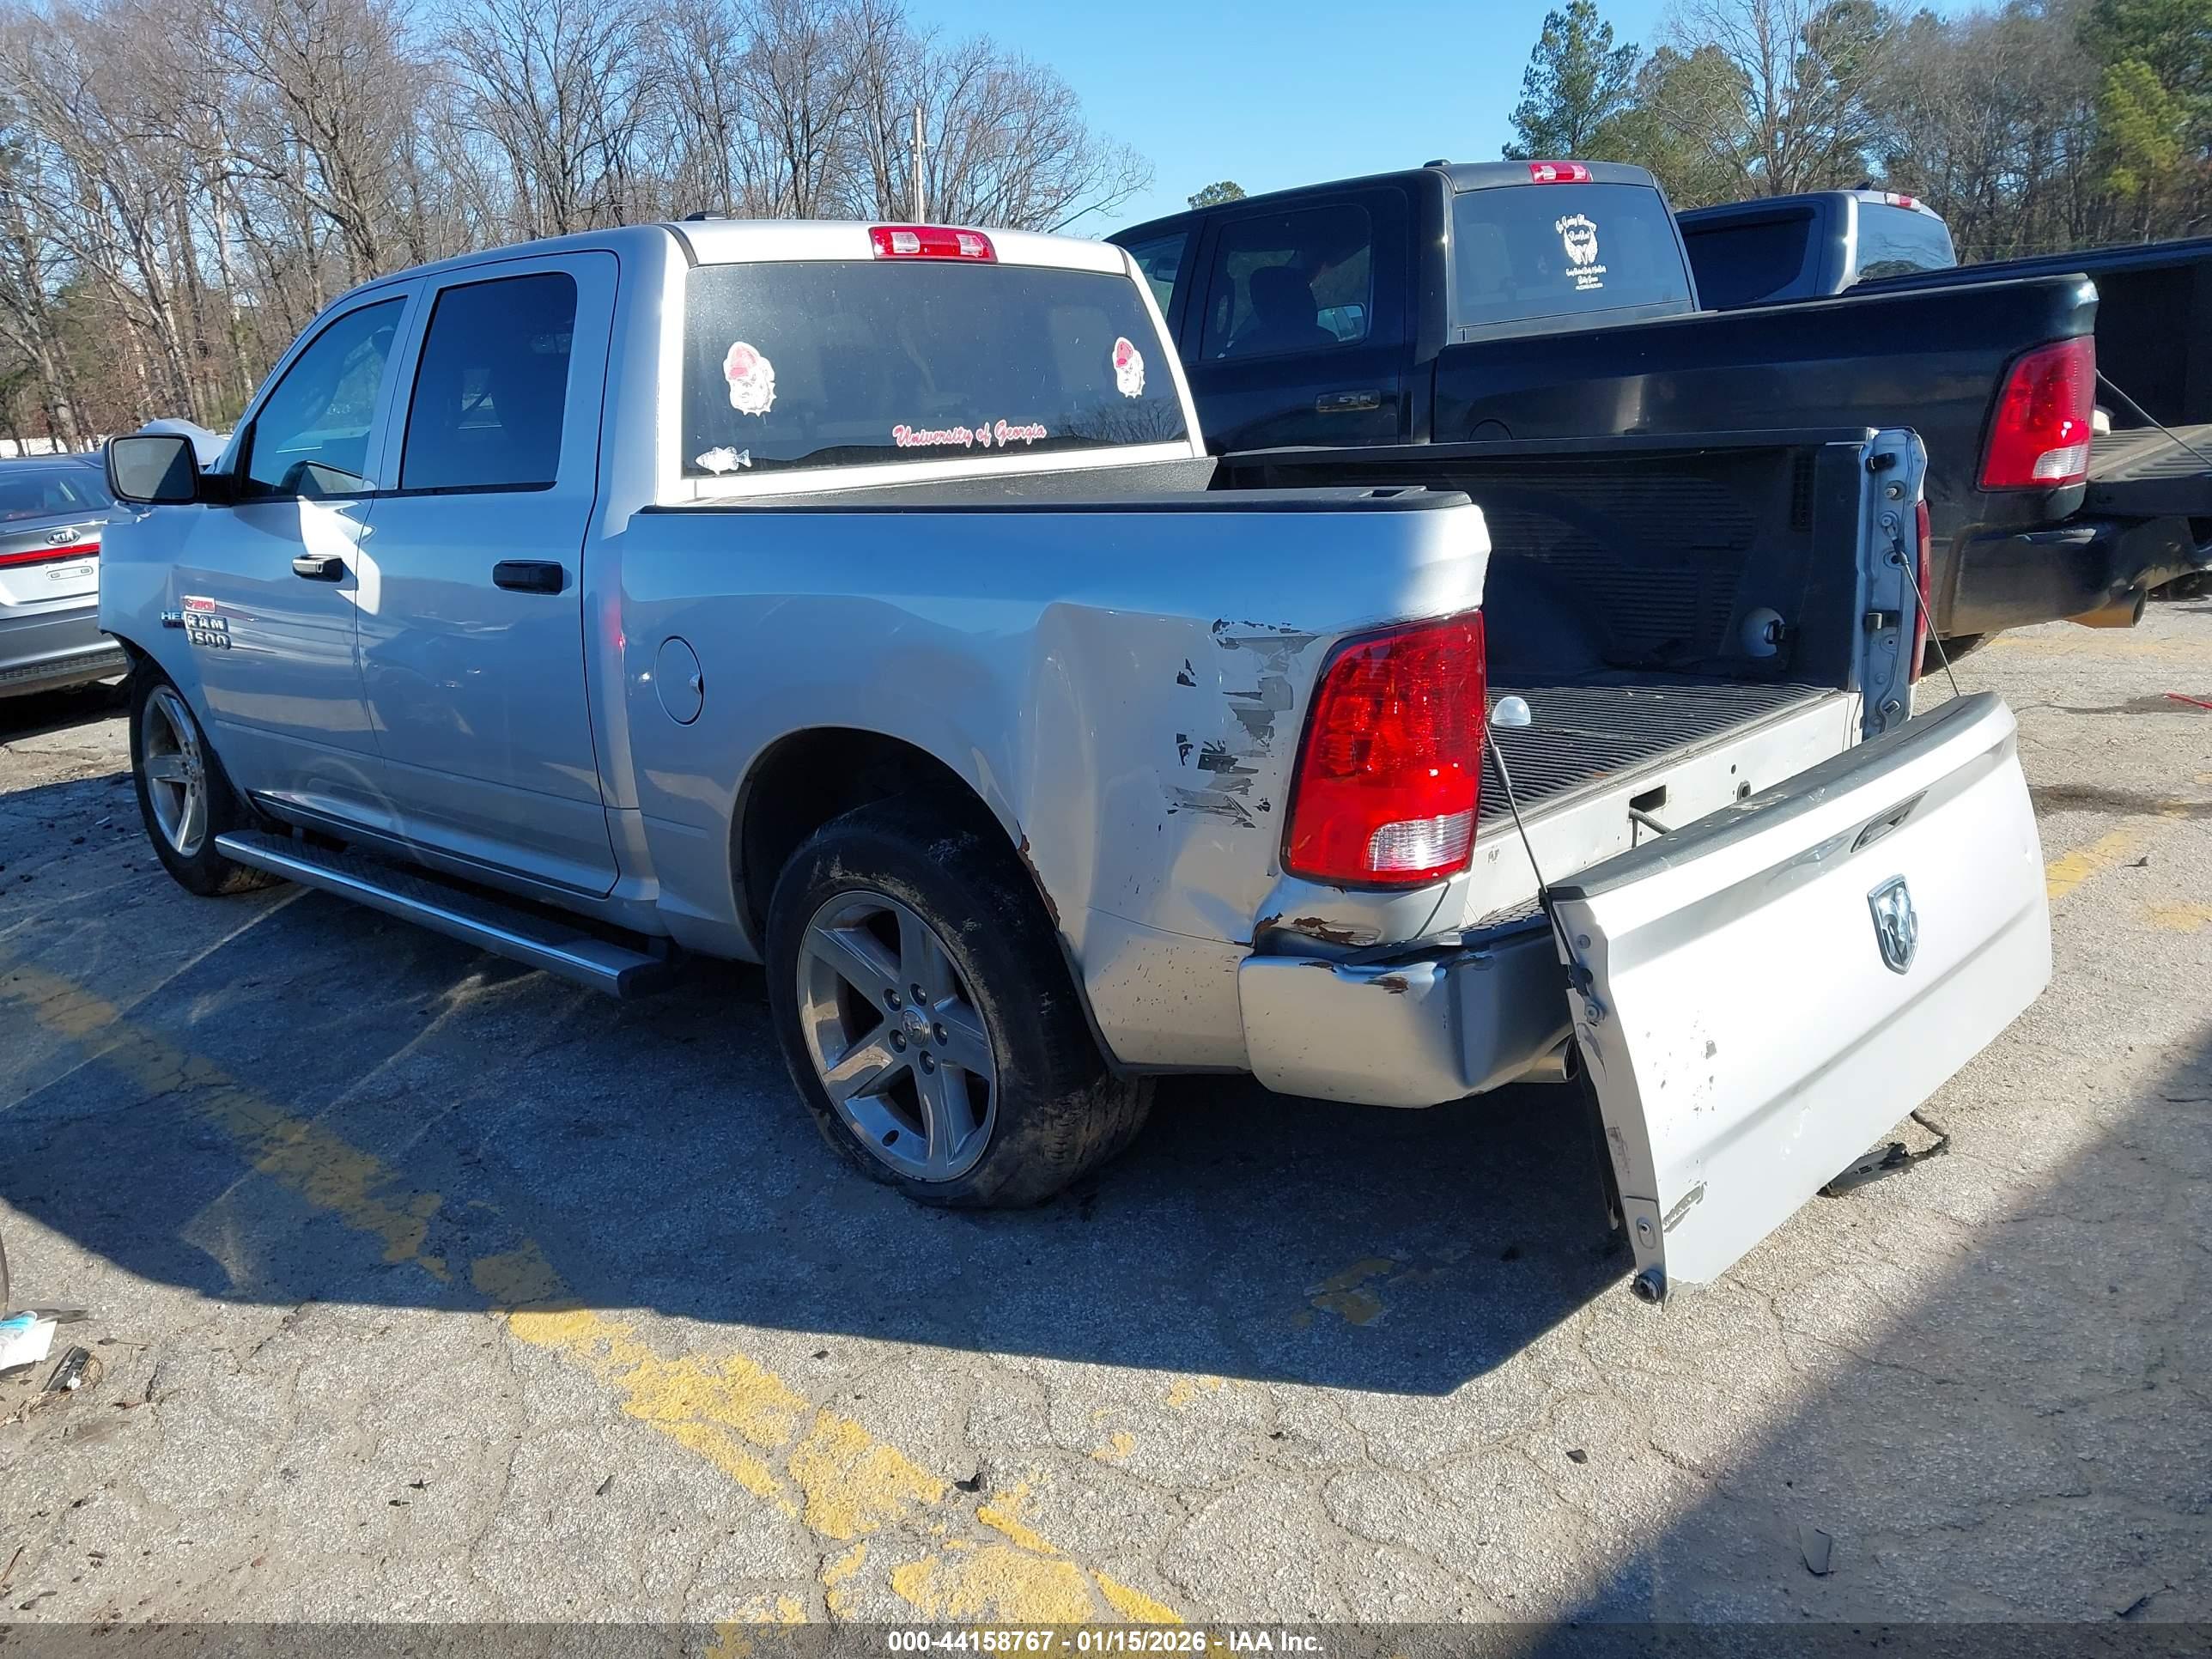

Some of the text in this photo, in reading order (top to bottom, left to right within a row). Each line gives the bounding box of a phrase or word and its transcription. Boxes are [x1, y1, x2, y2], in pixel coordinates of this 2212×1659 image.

[892, 419, 1048, 448] University of Georgia
[52, 530, 75, 543] KIA
[161, 611, 184, 620] HE
[187, 614, 227, 631] RAM
[187, 629, 230, 649] 1500
